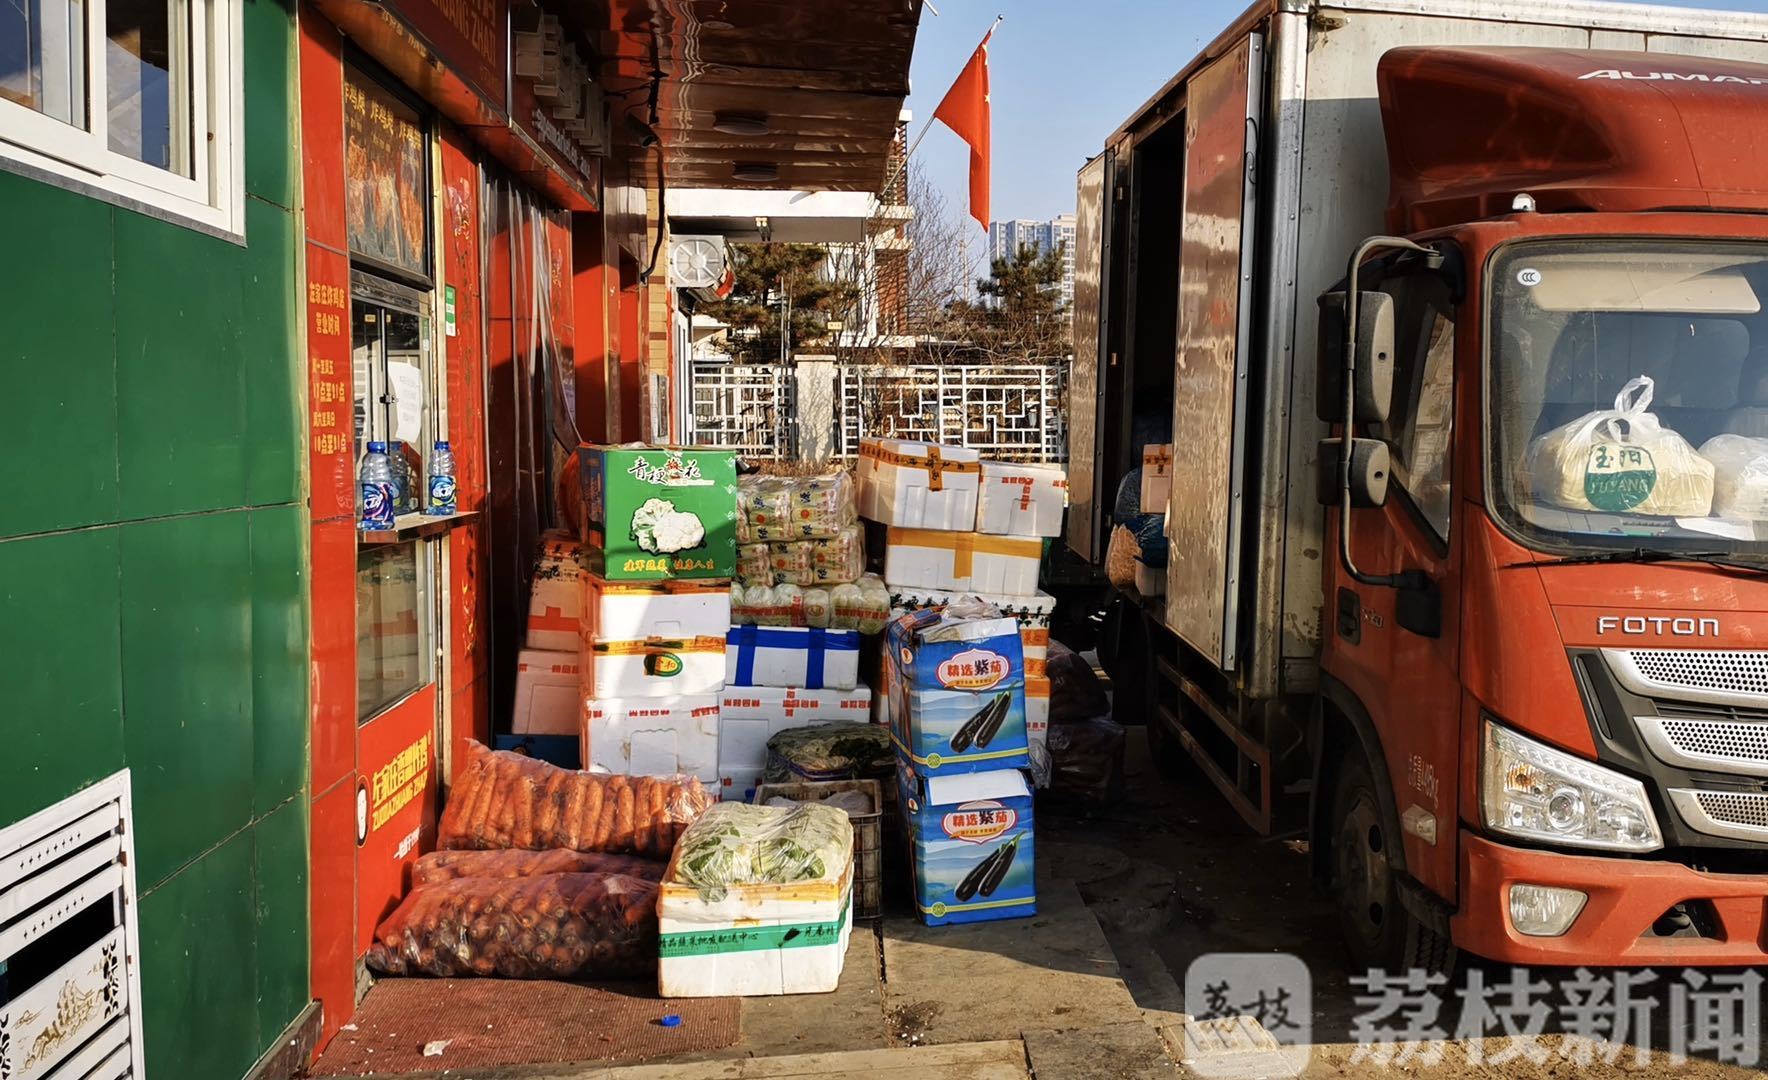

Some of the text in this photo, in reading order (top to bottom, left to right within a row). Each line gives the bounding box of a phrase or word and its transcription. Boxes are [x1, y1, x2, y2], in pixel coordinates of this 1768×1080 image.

[1597, 616, 1719, 636] FOTON
[947, 659, 1001, 676] 精选紫茄
[952, 810, 1008, 827] 精选紫茄
